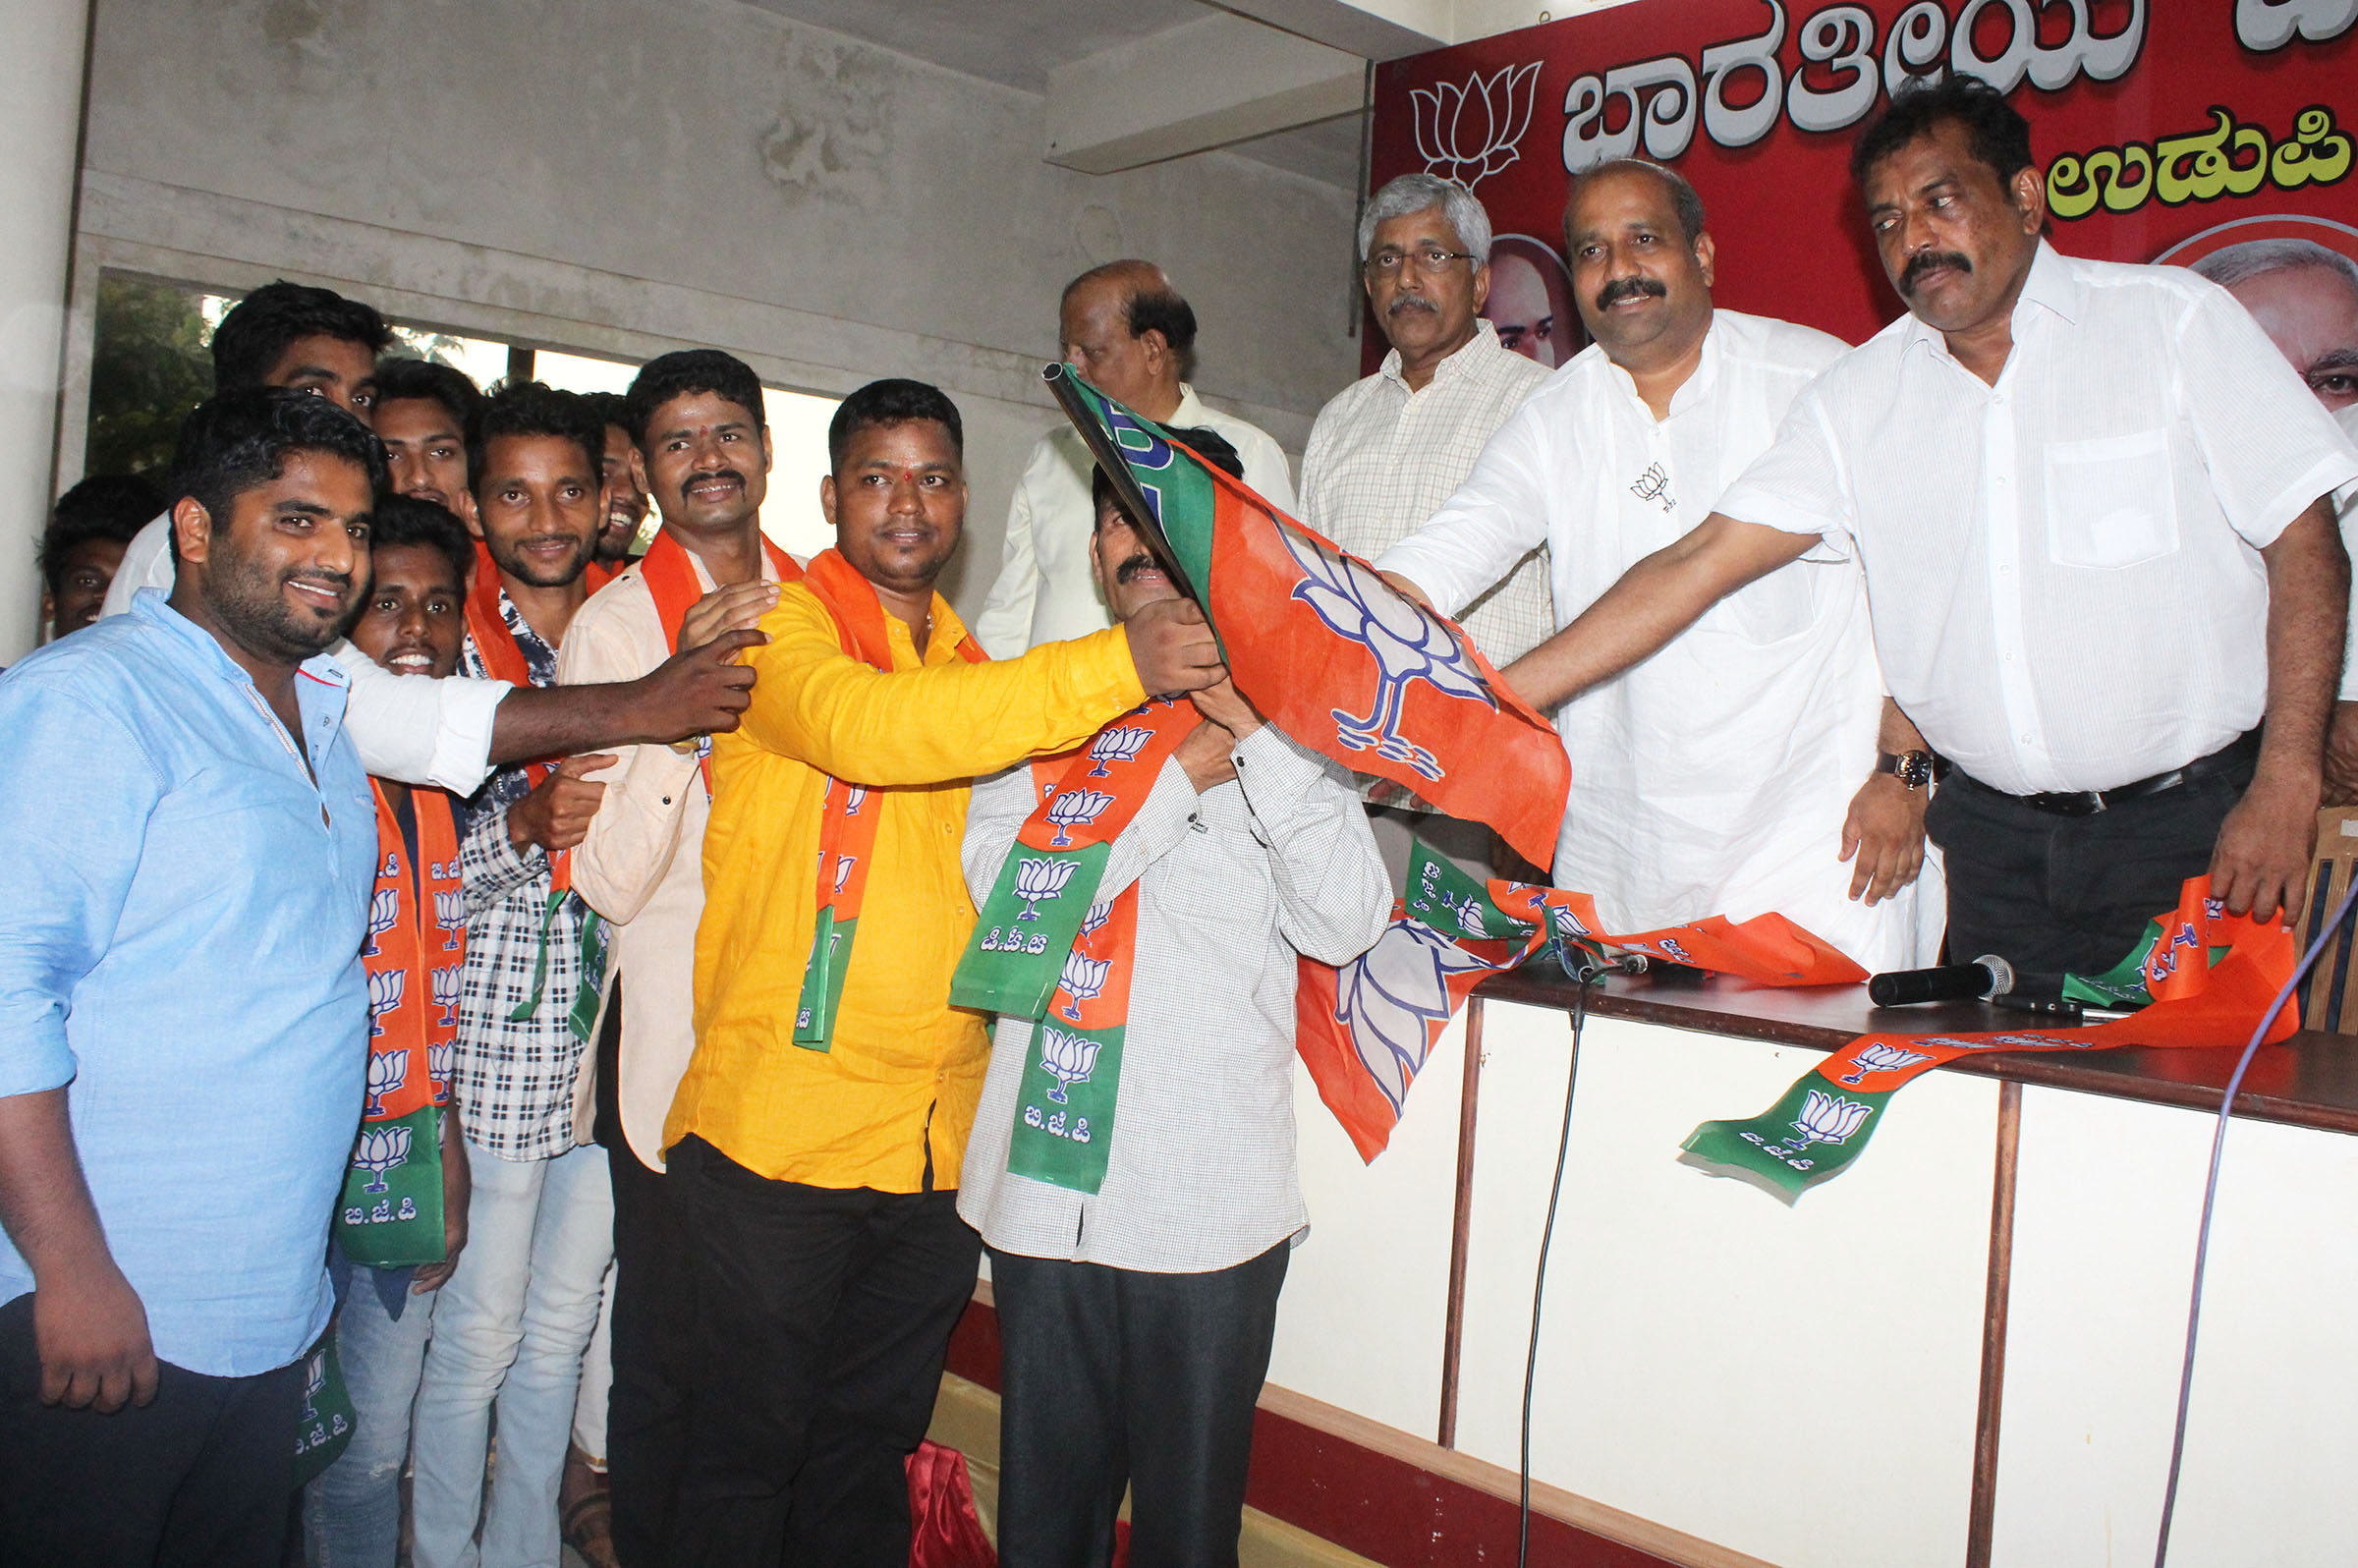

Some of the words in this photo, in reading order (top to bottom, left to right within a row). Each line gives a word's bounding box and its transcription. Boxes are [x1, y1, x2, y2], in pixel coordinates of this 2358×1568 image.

[2047, 108, 2353, 219] ಉಡುಪಿ
[1024, 1104, 1092, 1144] ಬಿ.ಜೆ.ಪಿ
[344, 1196, 418, 1225] ಬಿ.ಜೆ.ಪಿ
